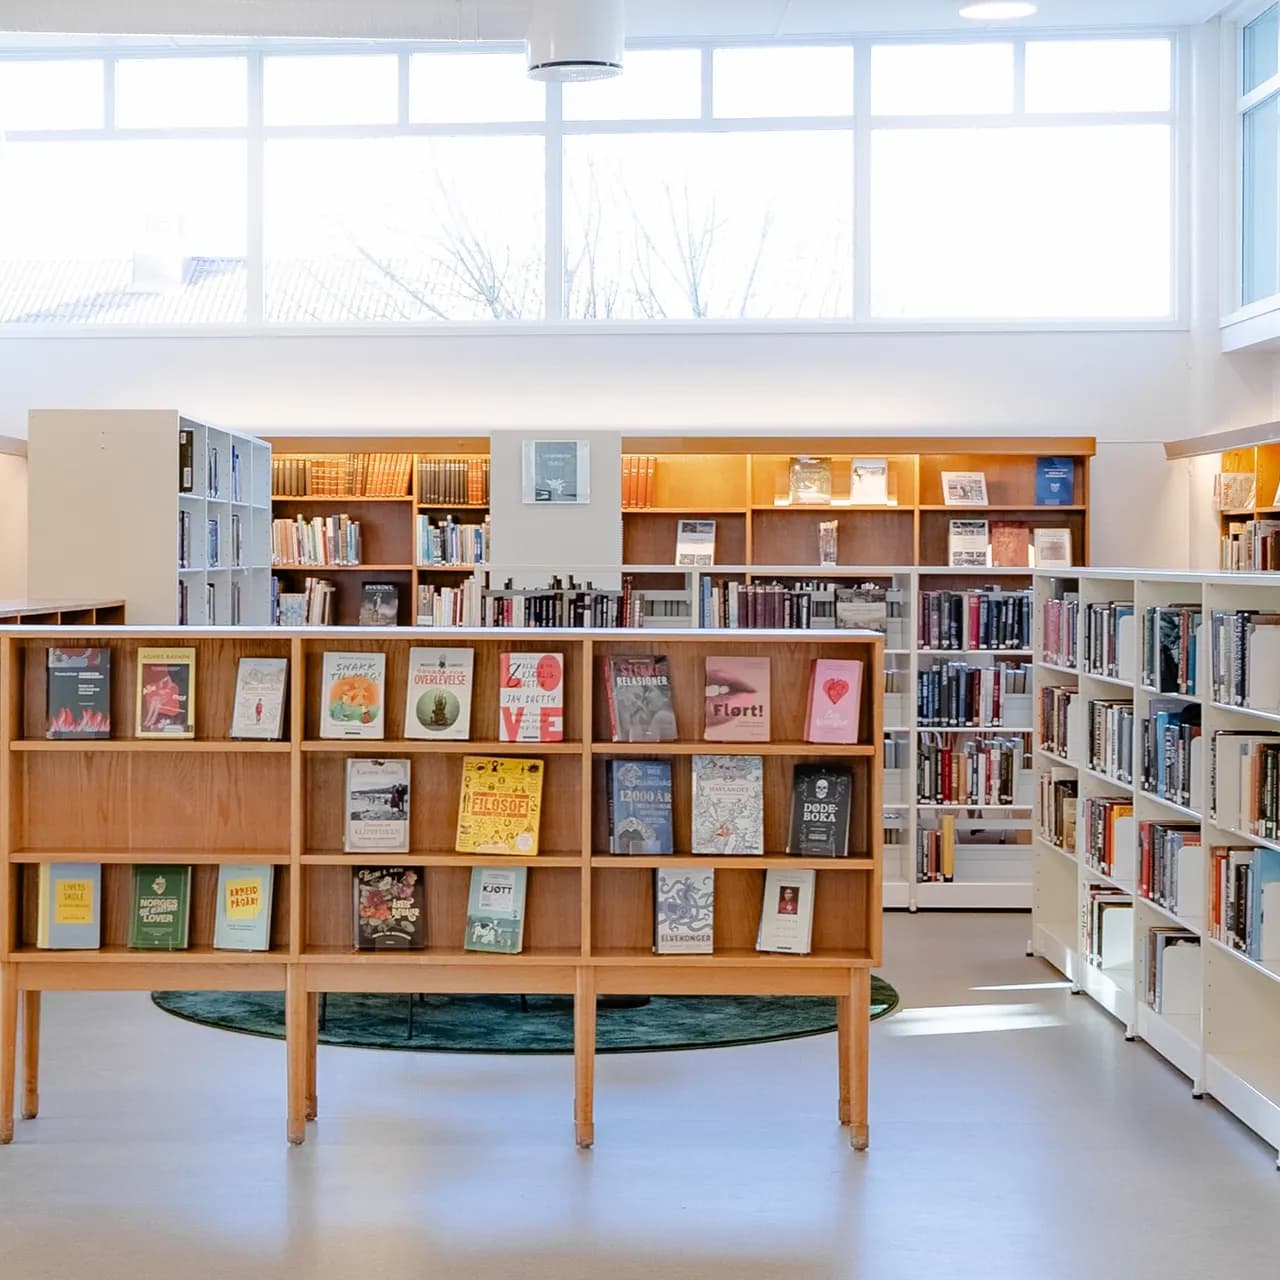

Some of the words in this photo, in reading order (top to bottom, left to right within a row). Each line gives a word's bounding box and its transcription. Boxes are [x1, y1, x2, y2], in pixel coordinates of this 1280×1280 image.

[335, 663, 377, 672] SNAKK
[330, 672, 349, 681] TIL
[414, 674, 467, 686] OVERLEVELSE
[713, 703, 764, 718] Flørt!
[471, 798, 529, 812] FILOSOFI
[803, 803, 839, 813] DØDE-
[803, 812, 837, 822] BOKA
[229, 886, 258, 897] ARBEID
[482, 885, 513, 895] KJØTT
[139, 899, 179, 908] NORGES
[143, 914, 174, 923] LOVER
[661, 934, 712, 943] ELVEKONGER
